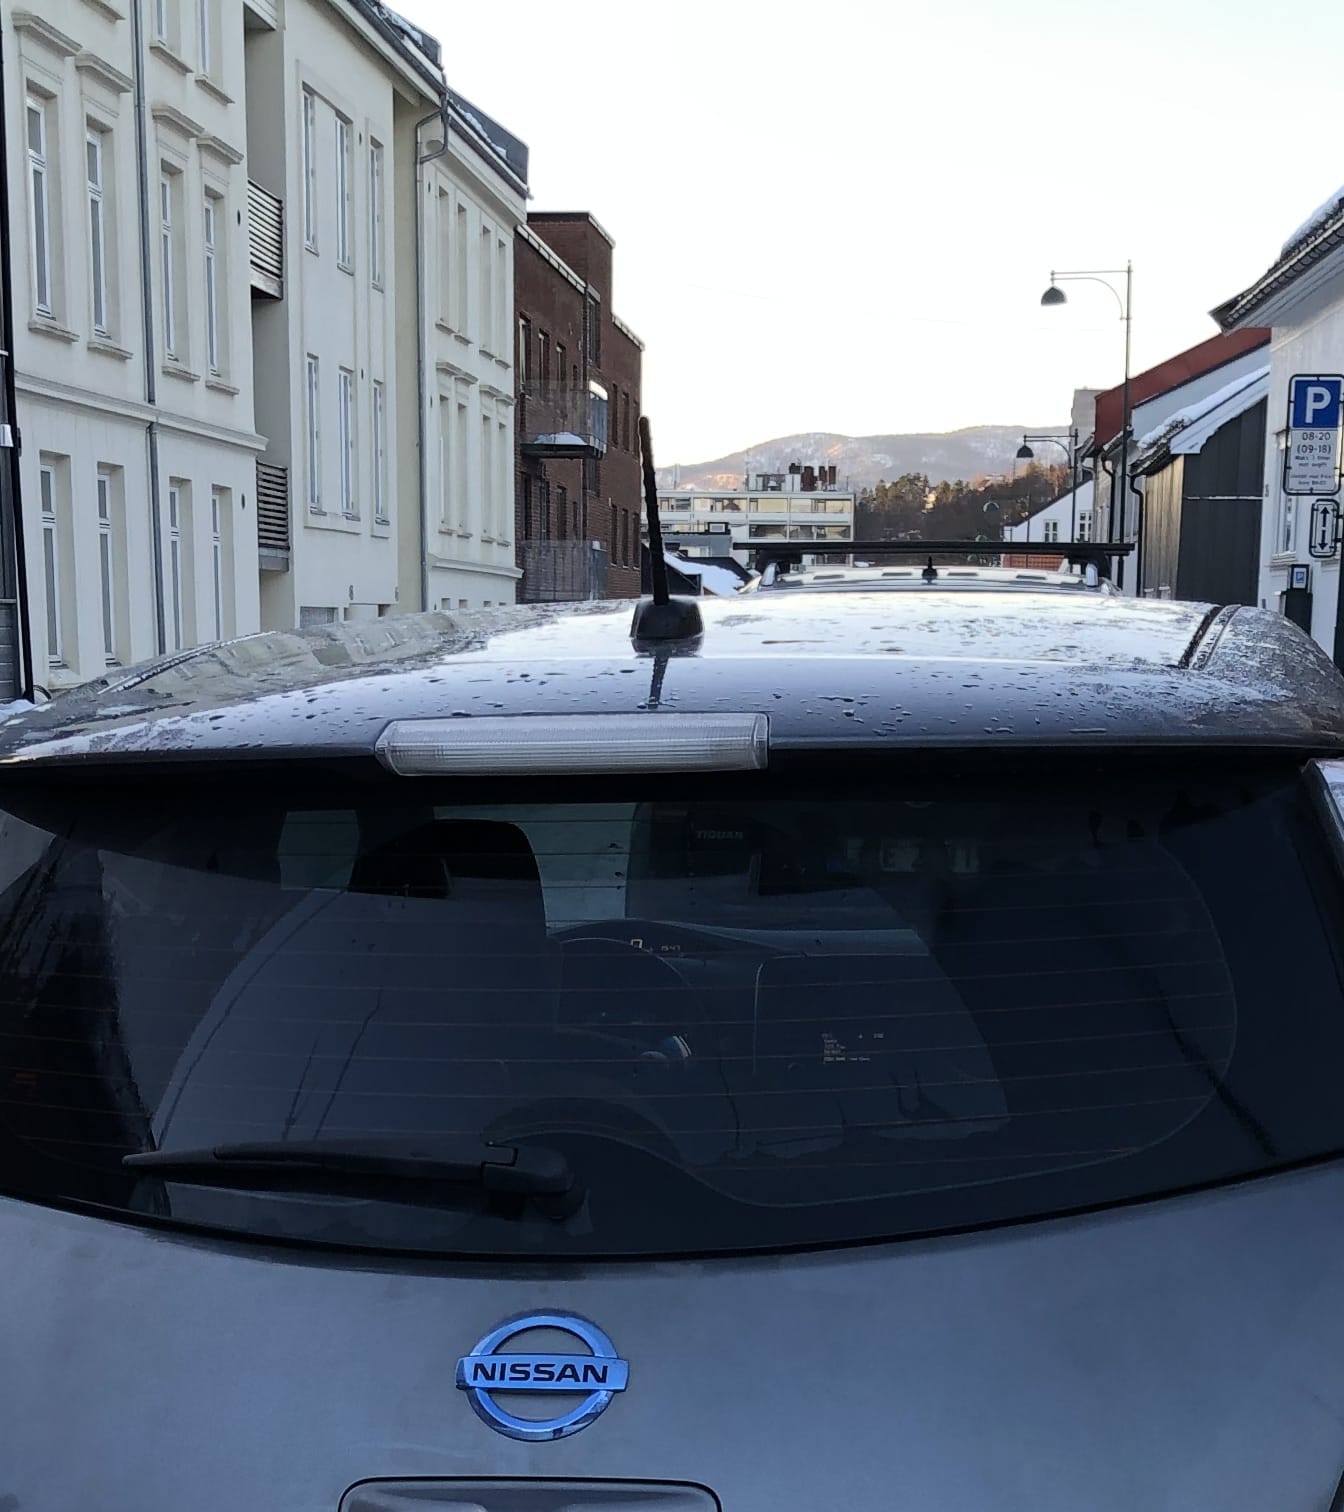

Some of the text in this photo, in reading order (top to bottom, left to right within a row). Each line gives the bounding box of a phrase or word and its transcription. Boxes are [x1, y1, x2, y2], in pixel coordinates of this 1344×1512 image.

[1306, 386, 1331, 423] P
[1302, 432, 1331, 441] 08-20
[1297, 444, 1331, 454] (09-18)
[472, 1362, 609, 1384] NISSAN
